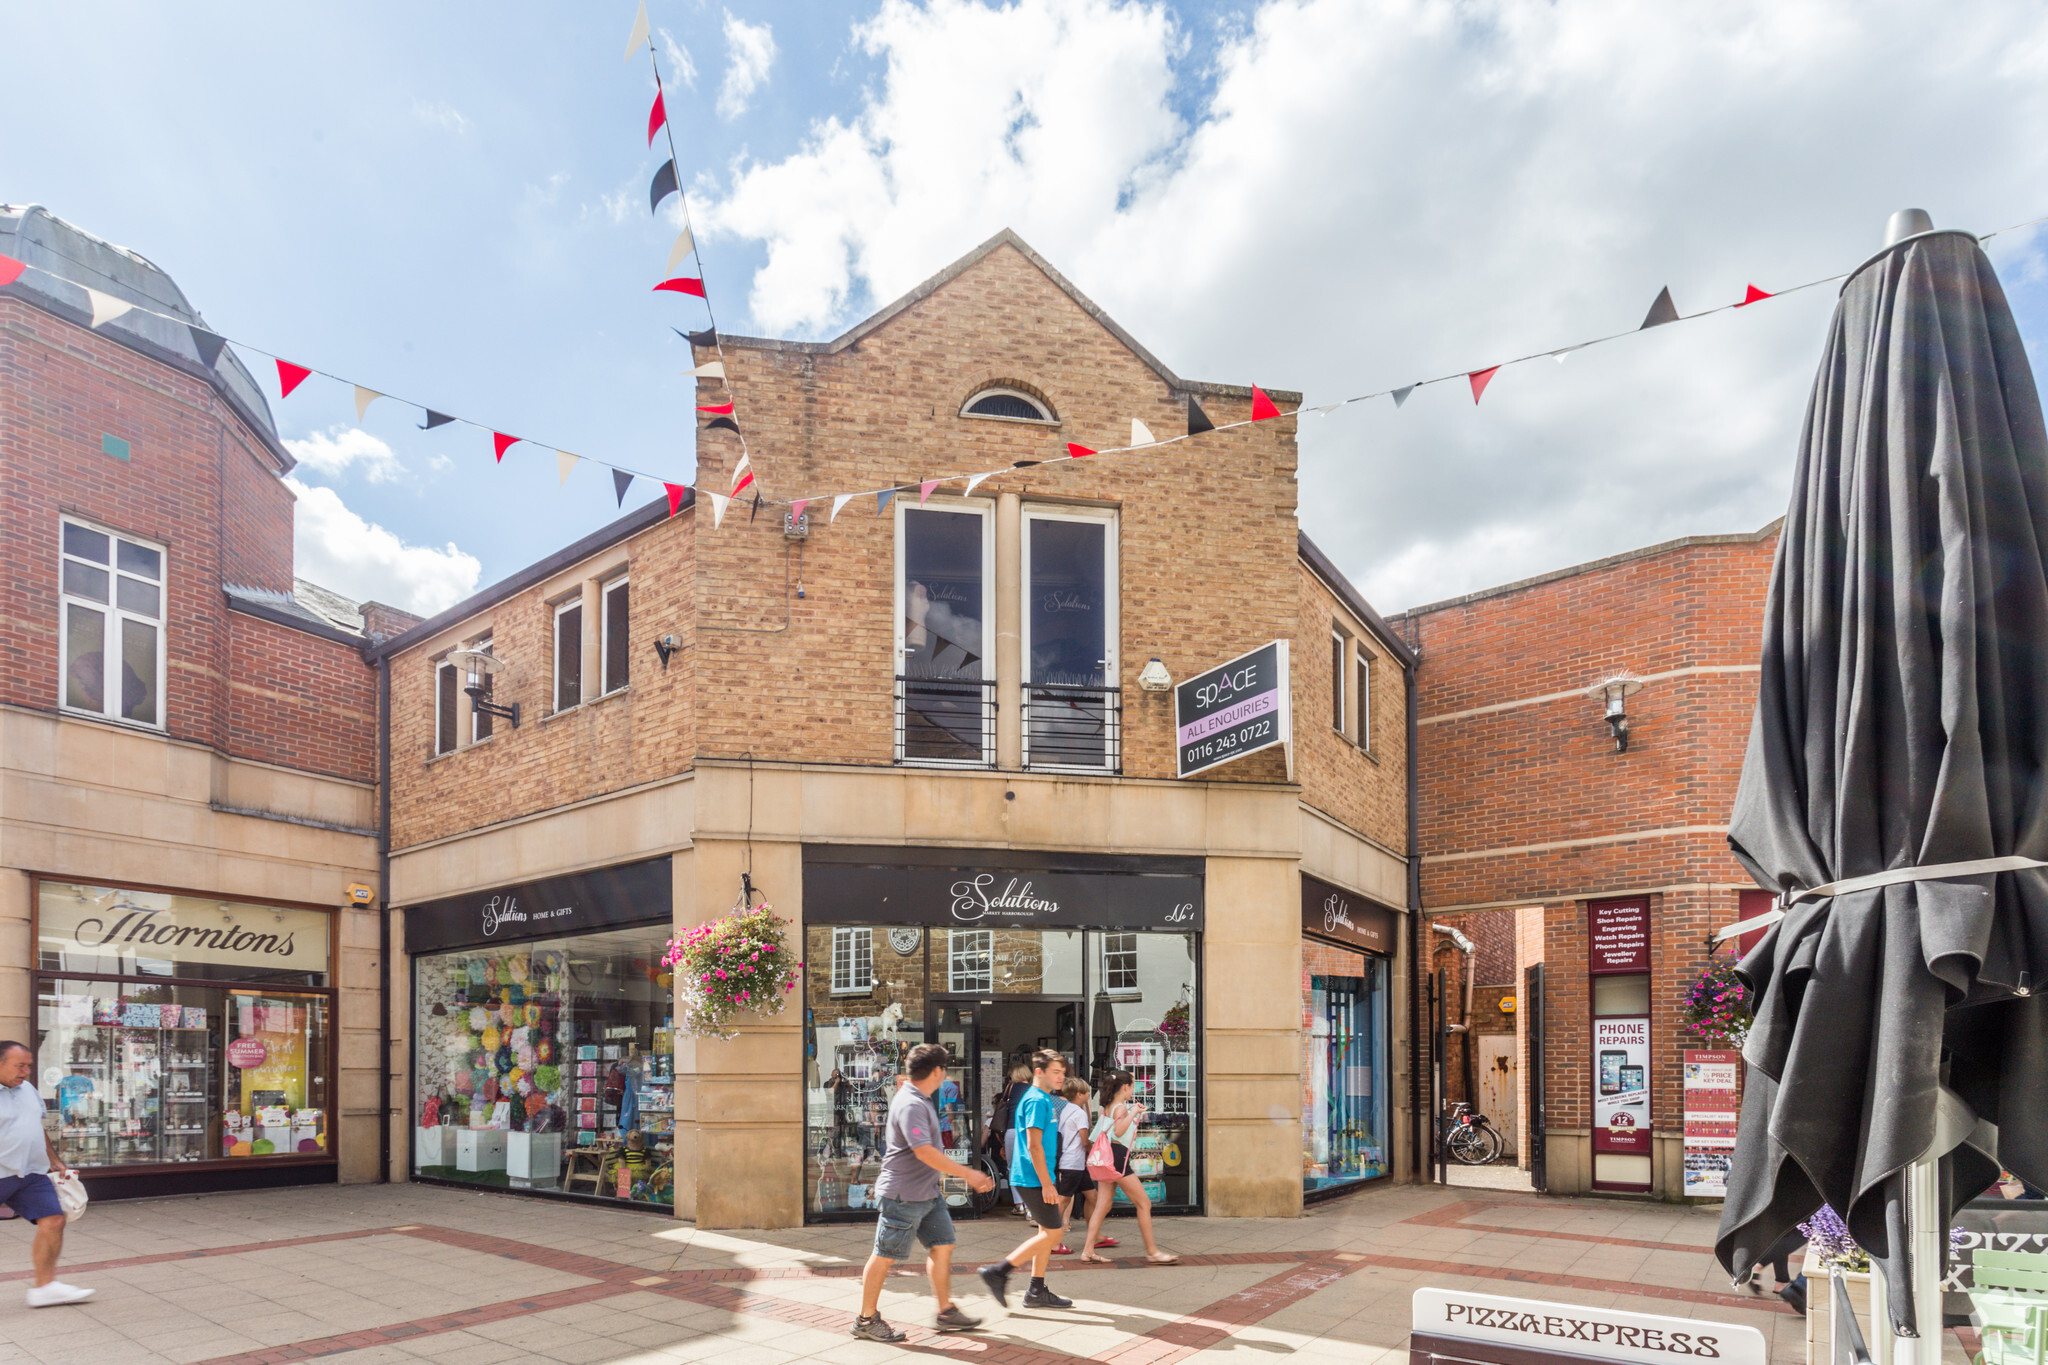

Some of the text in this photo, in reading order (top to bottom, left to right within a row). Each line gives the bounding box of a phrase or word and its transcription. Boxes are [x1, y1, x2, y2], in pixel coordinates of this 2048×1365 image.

[1187, 697, 1270, 739] ALL ENQUIRIES
[1188, 720, 1270, 763] 0116 243 0722
[482, 895, 527, 936] Solutions
[533, 911, 549, 920] HOME
[556, 907, 572, 917] GIFTS
[950, 873, 1060, 920] Solutions
[1324, 894, 1354, 932] Solutions
[1357, 926, 1366, 935] HOME
[1370, 931, 1379, 939] GIFTS
[75, 904, 294, 956] Thorntons
[1012, 950, 1038, 968] GIFTS
[1599, 1036, 1645, 1045] REPAIRS
[1600, 1024, 1645, 1034] PHONE
[1616, 1116, 1628, 1124] 12
[1445, 1302, 1721, 1358] PIZZAEXPRESS
